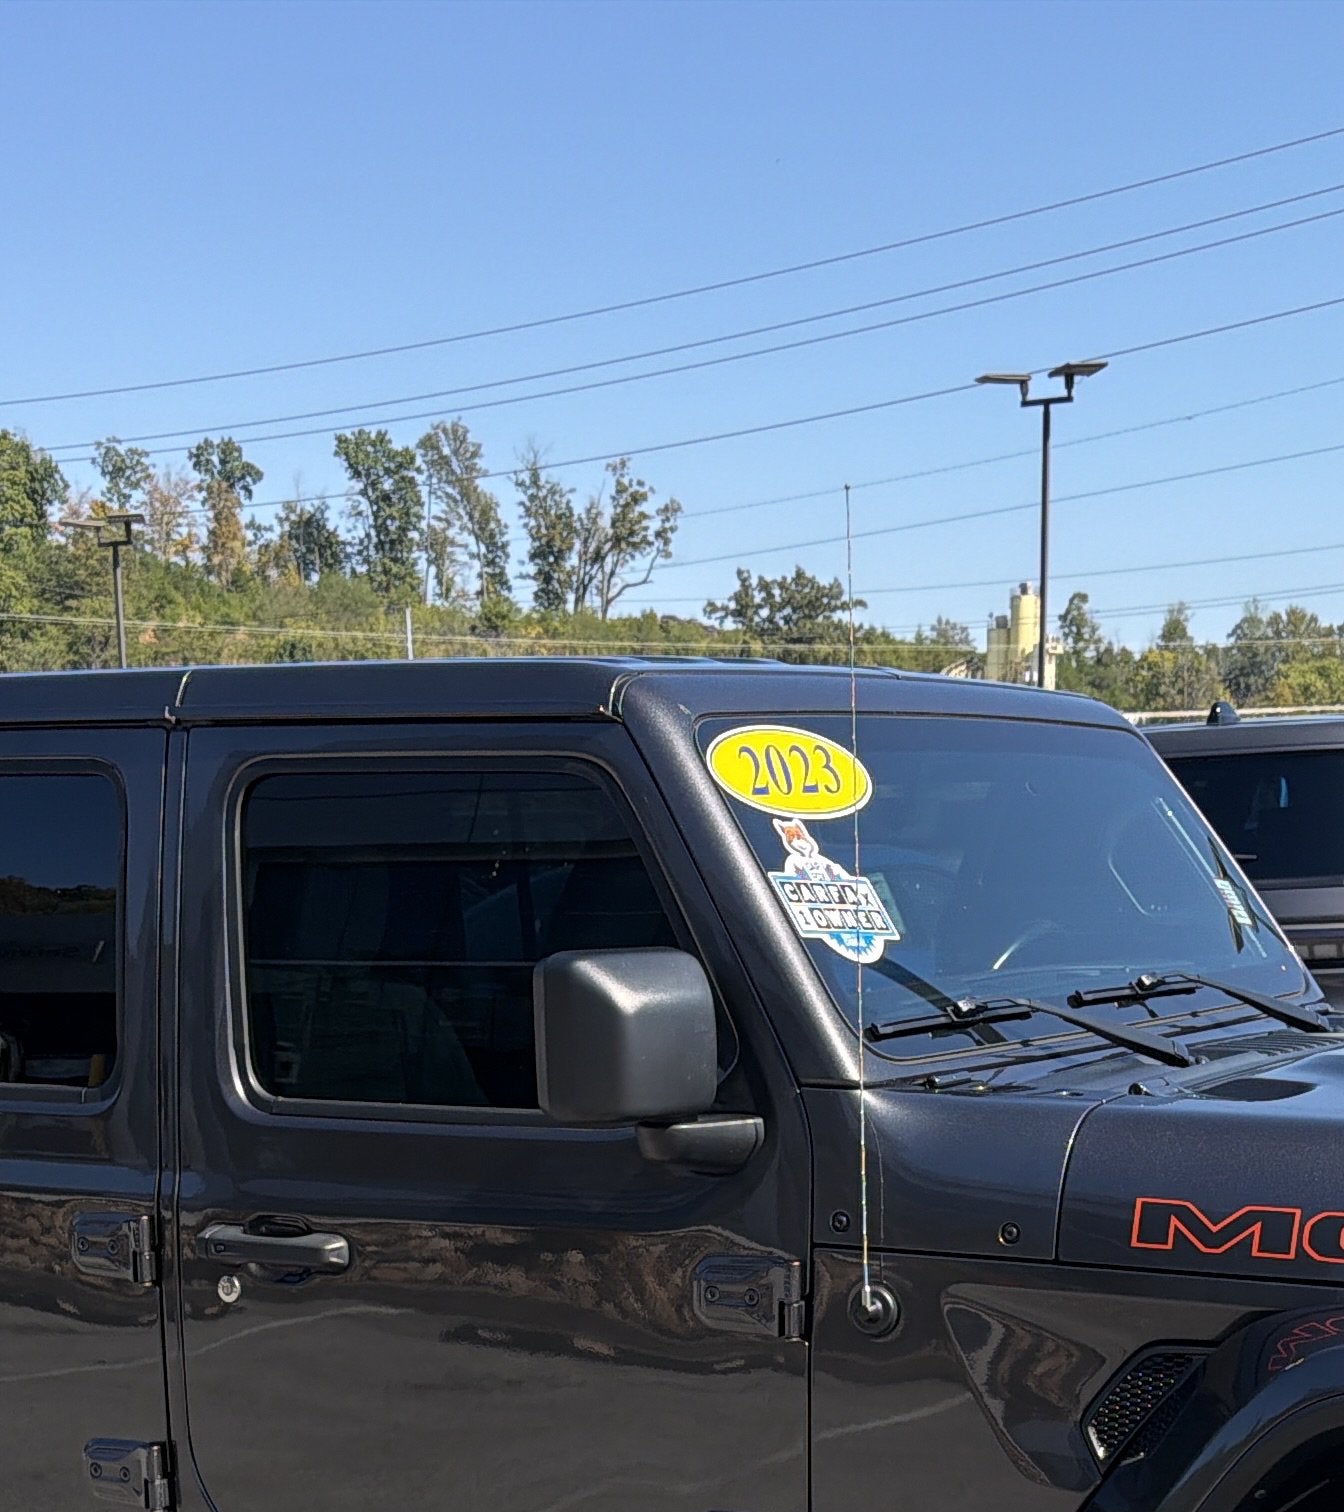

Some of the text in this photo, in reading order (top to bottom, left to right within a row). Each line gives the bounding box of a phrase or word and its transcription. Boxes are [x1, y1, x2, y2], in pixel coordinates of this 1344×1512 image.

[737, 744, 842, 796] 2023
[779, 881, 875, 907] CARFAX
[808, 907, 890, 930] OWNER
